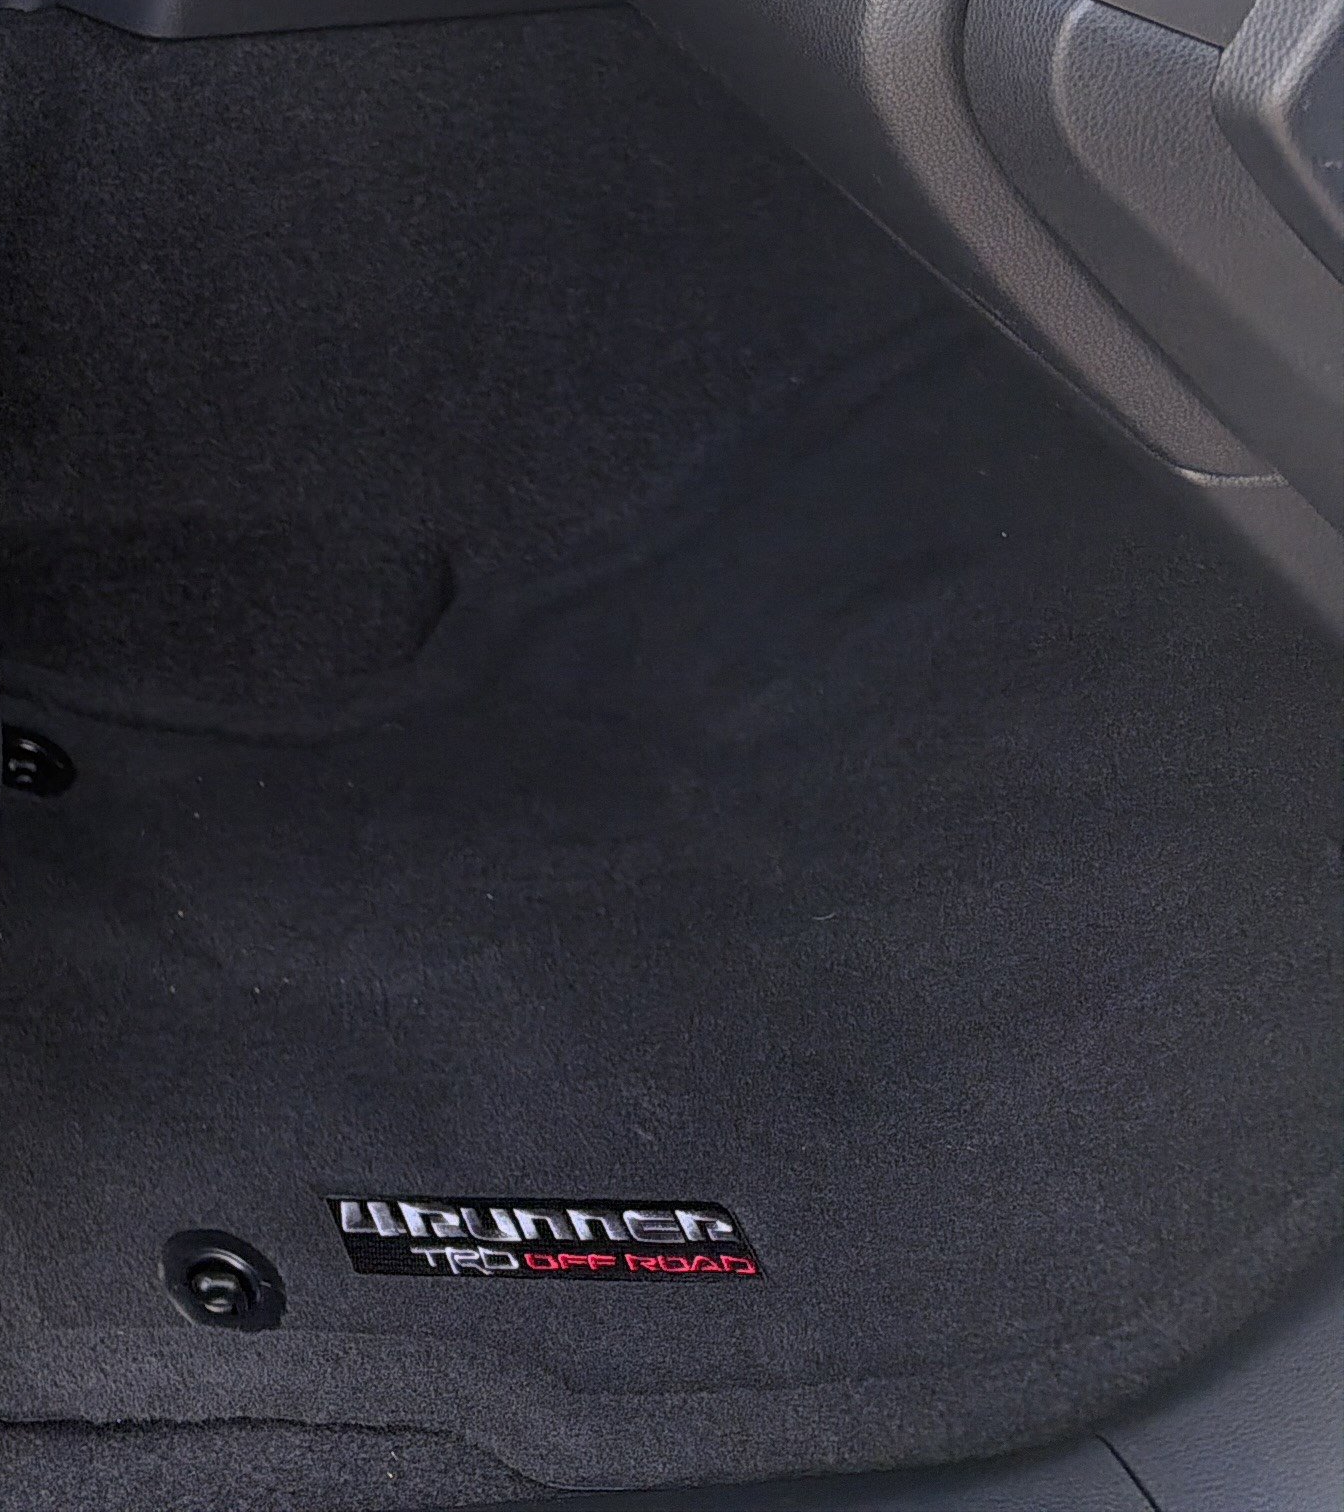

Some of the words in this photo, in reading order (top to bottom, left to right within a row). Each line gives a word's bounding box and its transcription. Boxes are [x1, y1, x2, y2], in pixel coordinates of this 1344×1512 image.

[339, 1200, 740, 1244] 4RUNNER
[409, 1246, 520, 1276] TRD
[523, 1252, 617, 1273] OFF
[624, 1252, 759, 1276] ROAD
